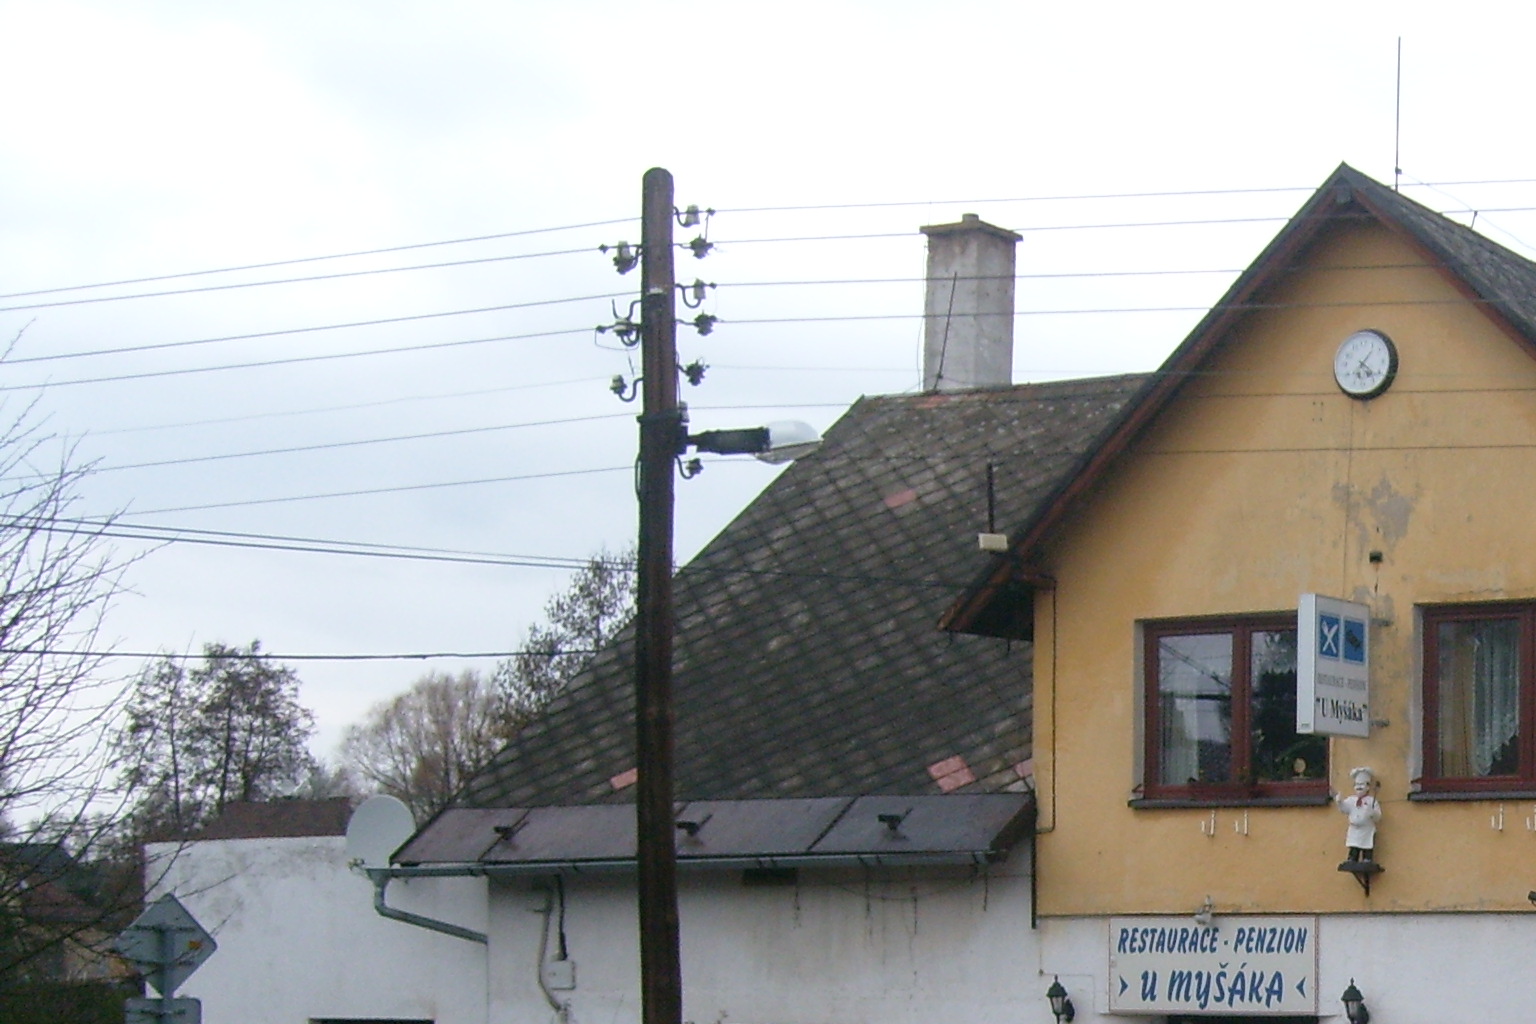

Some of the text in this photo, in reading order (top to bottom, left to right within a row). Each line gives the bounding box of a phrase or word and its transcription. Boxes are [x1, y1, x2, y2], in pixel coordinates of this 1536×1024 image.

[1118, 926, 1308, 954] RESTAURACE PENZION
[1140, 962, 1284, 1010] U MYŠÁKA
